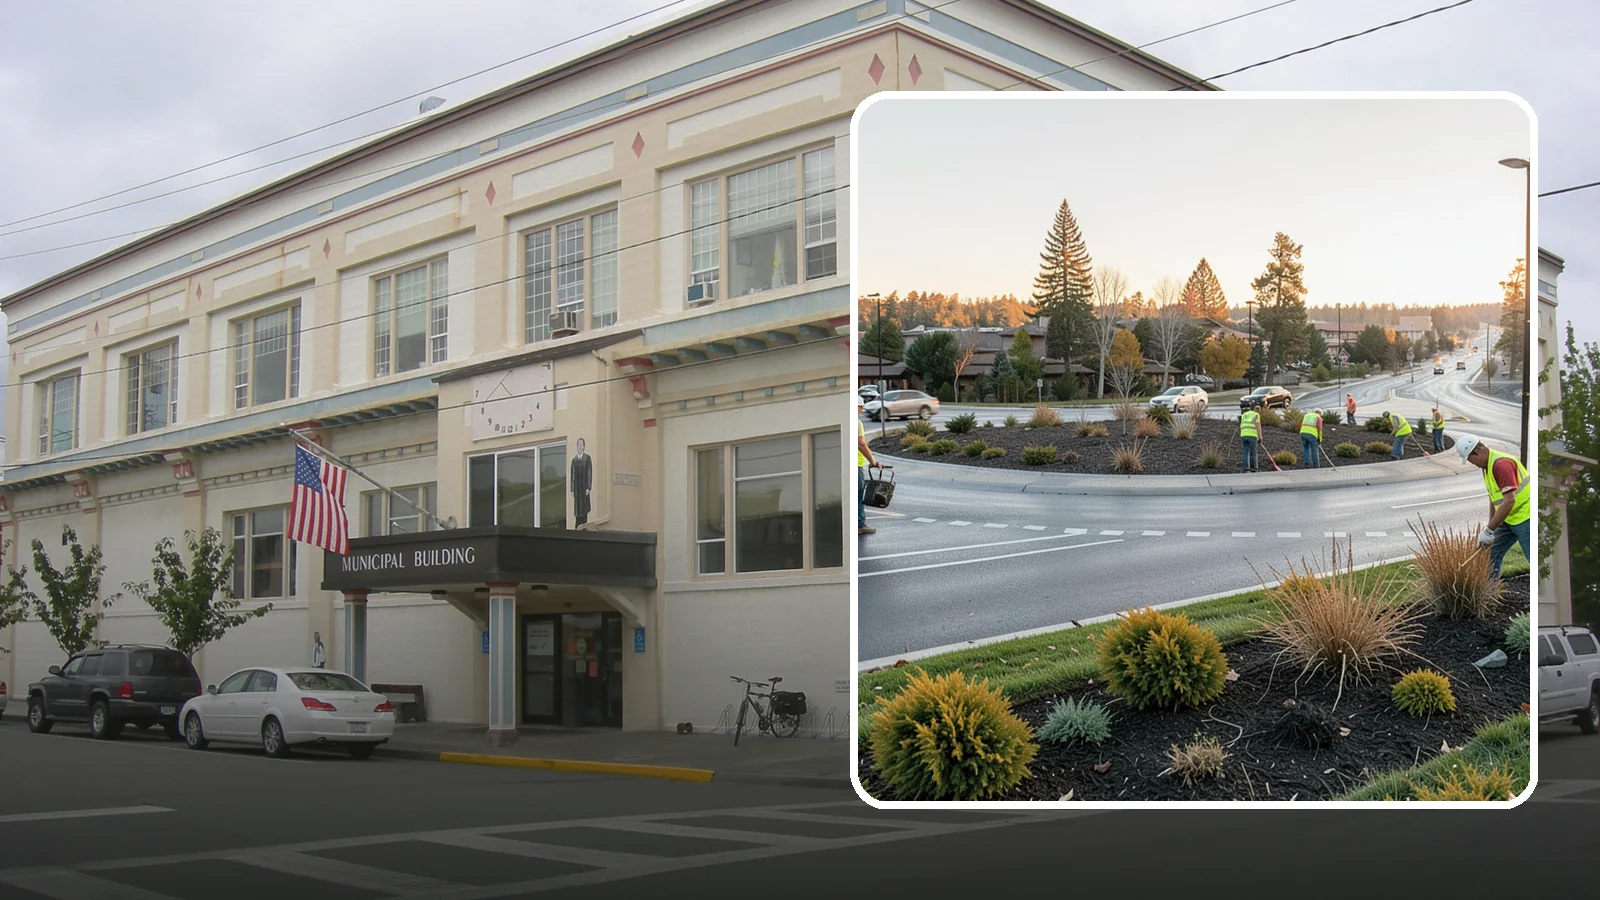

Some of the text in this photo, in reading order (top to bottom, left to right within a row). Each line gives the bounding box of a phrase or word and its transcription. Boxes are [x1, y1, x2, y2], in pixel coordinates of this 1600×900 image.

[480, 406, 485, 415] 8
[488, 417, 492, 426] 9
[494, 424, 500, 432] 10
[502, 426, 506, 434] 11
[508, 426, 513, 434] 12
[521, 420, 526, 428] 2
[529, 414, 533, 422] 3
[342, 546, 475, 572] MUNICIPAL BUILDING
